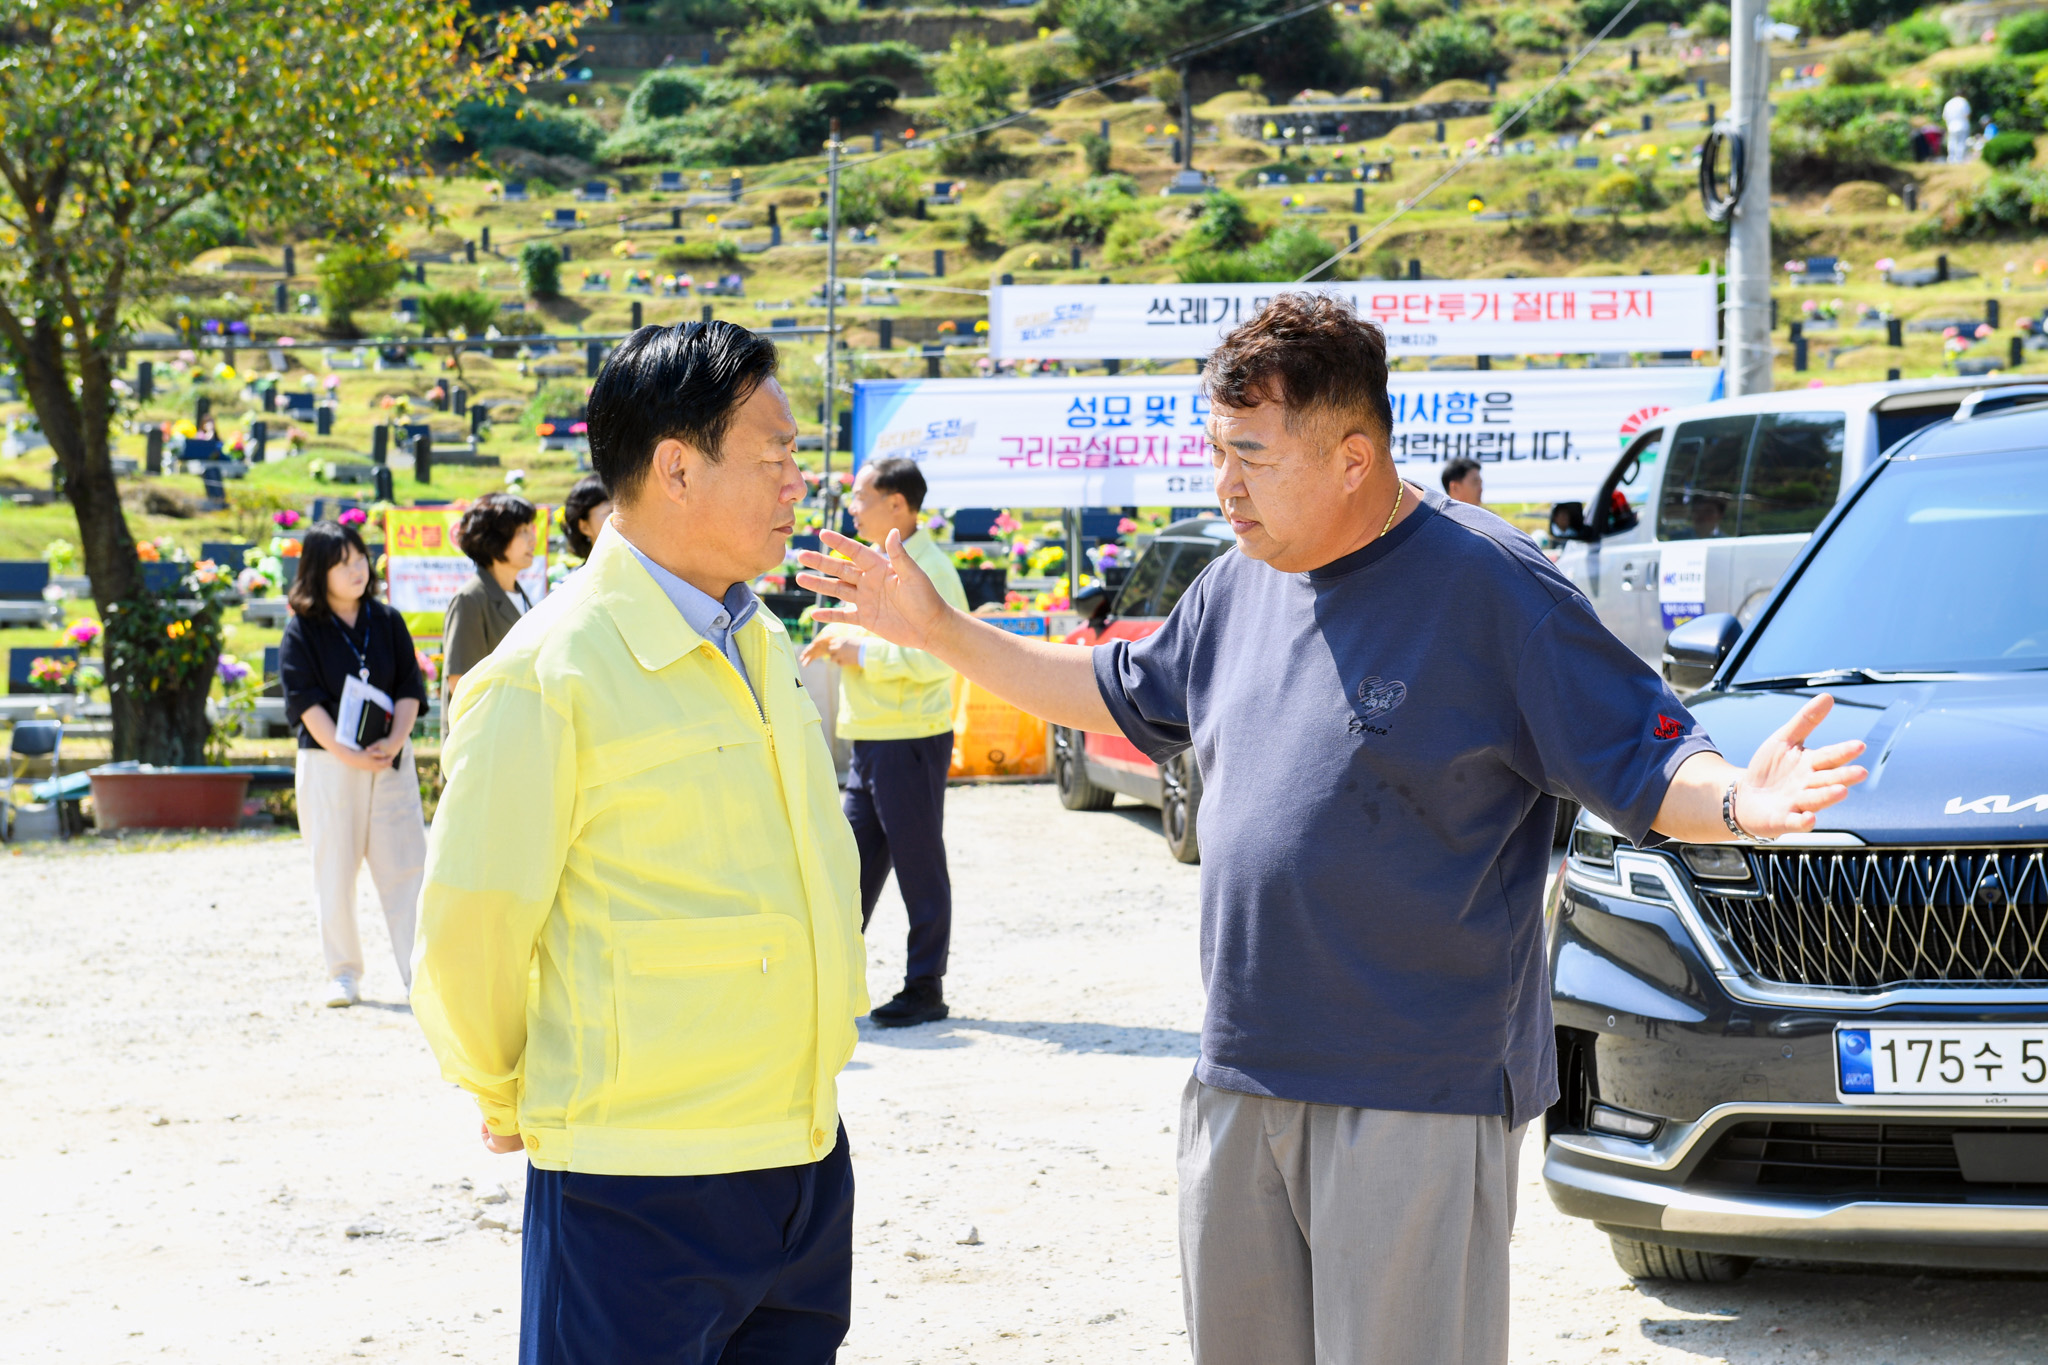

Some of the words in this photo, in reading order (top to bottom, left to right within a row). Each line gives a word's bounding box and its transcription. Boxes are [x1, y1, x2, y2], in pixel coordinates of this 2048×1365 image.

[1147, 297, 1240, 325] 쓰레기
[1370, 293, 1499, 323] 무단투기
[1513, 291, 1576, 322] 절대
[1589, 289, 1653, 320] 금지
[1067, 396, 1132, 428] 성묘
[1145, 396, 1176, 427] 및
[998, 435, 1168, 469] 구리공설묘지
[1880, 1039, 2003, 1083] 175수
[2021, 1039, 2047, 1083] 5
